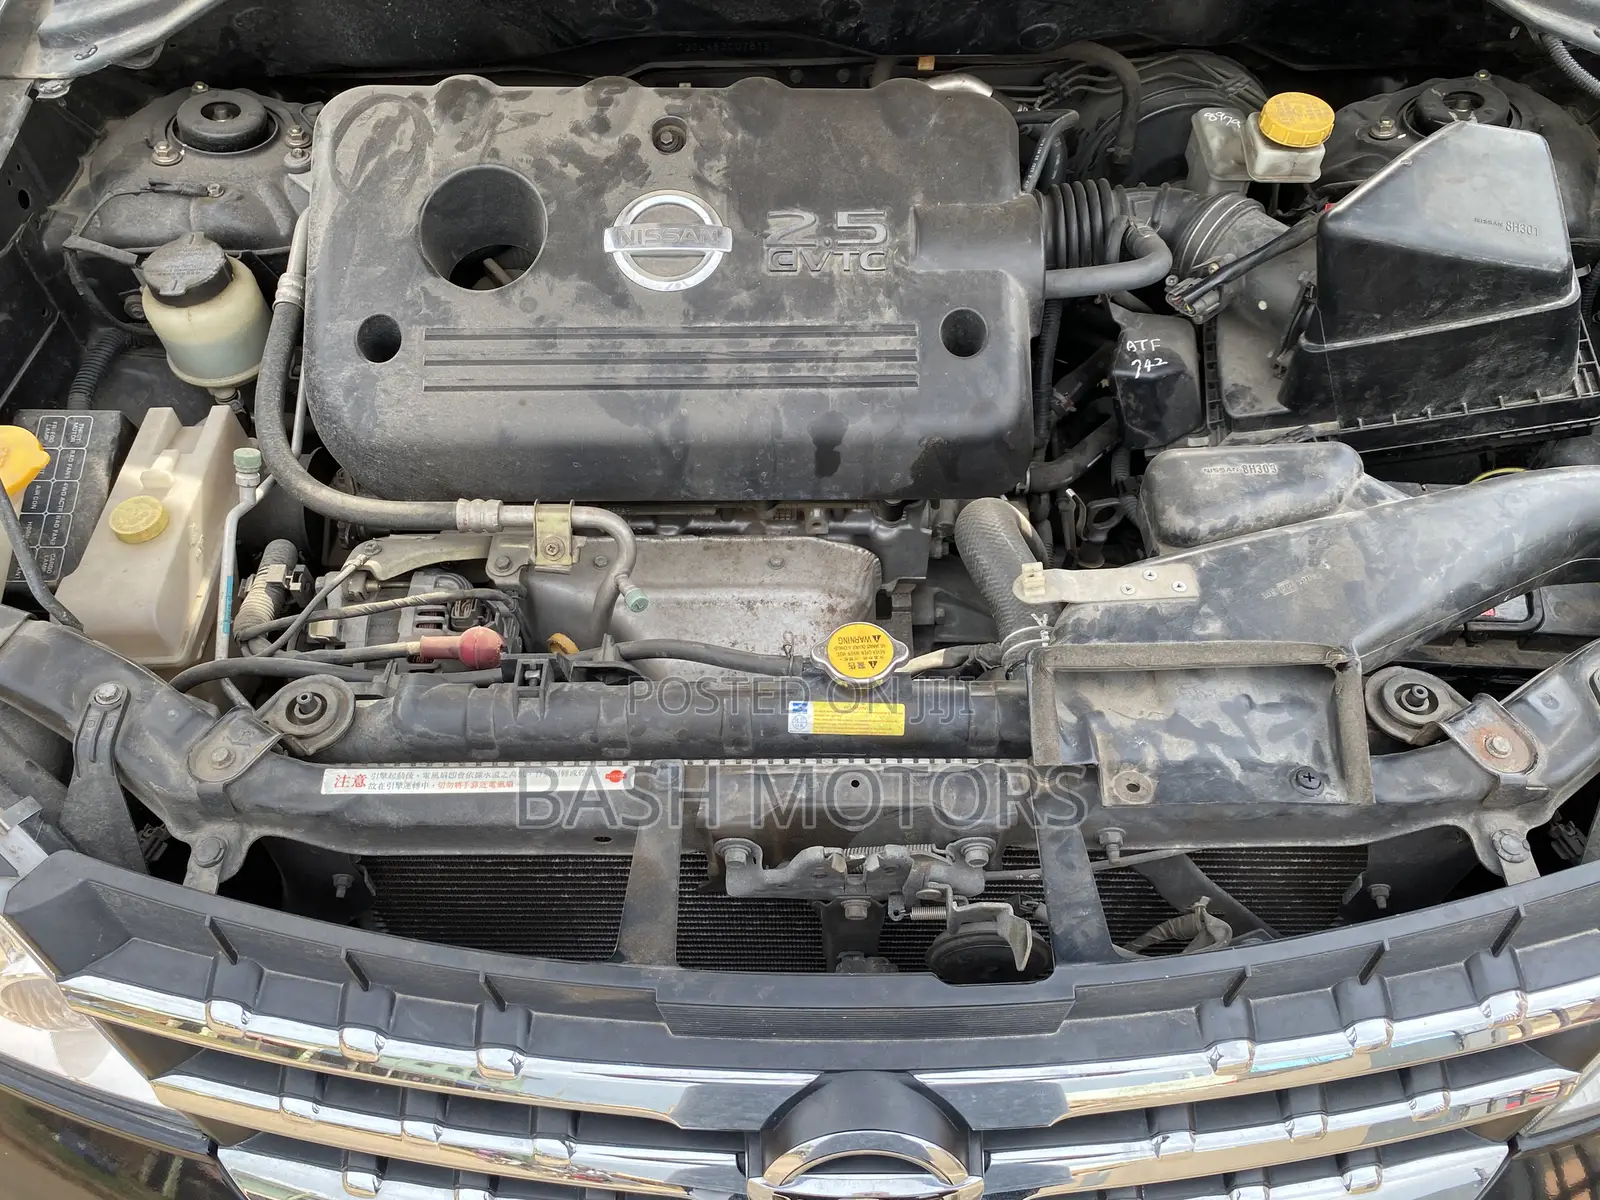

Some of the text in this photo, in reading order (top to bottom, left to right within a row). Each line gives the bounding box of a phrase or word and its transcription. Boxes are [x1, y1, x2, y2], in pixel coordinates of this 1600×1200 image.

[763, 210, 889, 249] 2.5
[616, 227, 720, 247] NISSAN
[1126, 338, 1161, 352] ATF
[69, 422, 79, 443] MOTOR
[67, 450, 76, 462] RAD
[1241, 463, 1278, 475] 8H303
[53, 515, 62, 529] RAD
[838, 636, 872, 645] WARNING
[334, 773, 367, 788] 注意
